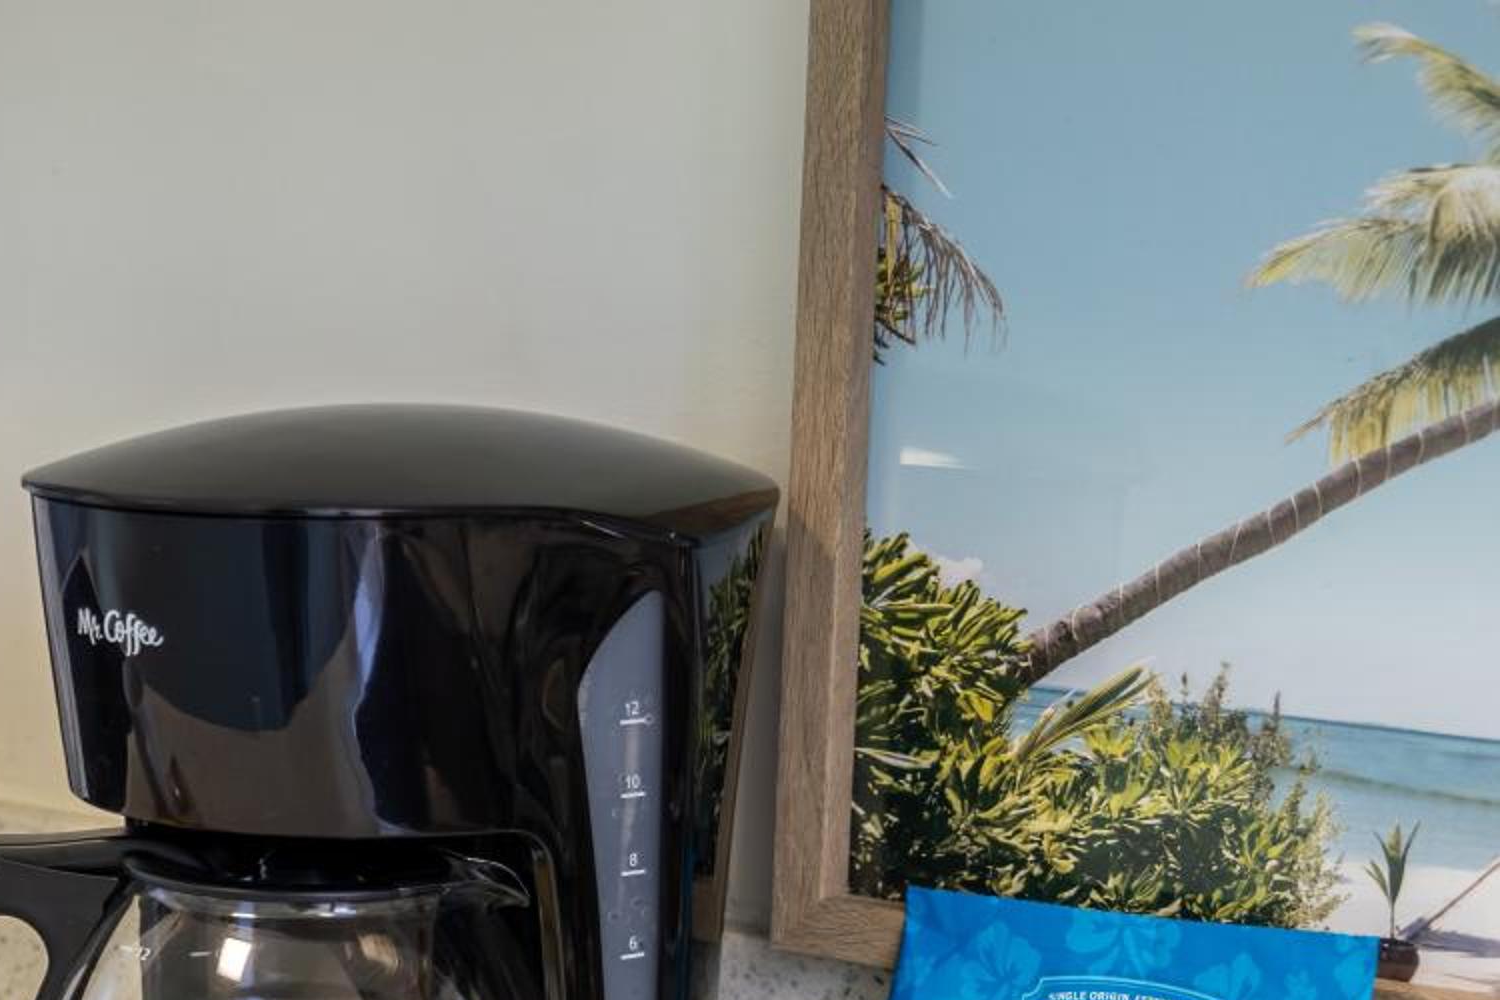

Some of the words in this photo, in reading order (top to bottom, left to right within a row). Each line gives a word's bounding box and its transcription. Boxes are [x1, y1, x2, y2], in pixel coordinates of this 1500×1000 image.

[77, 607, 103, 646] Mr.
[103, 609, 164, 657] Coffee
[625, 701, 640, 716] 12
[626, 774, 640, 789] 10
[628, 853, 638, 867] 8
[629, 936, 638, 951] 6
